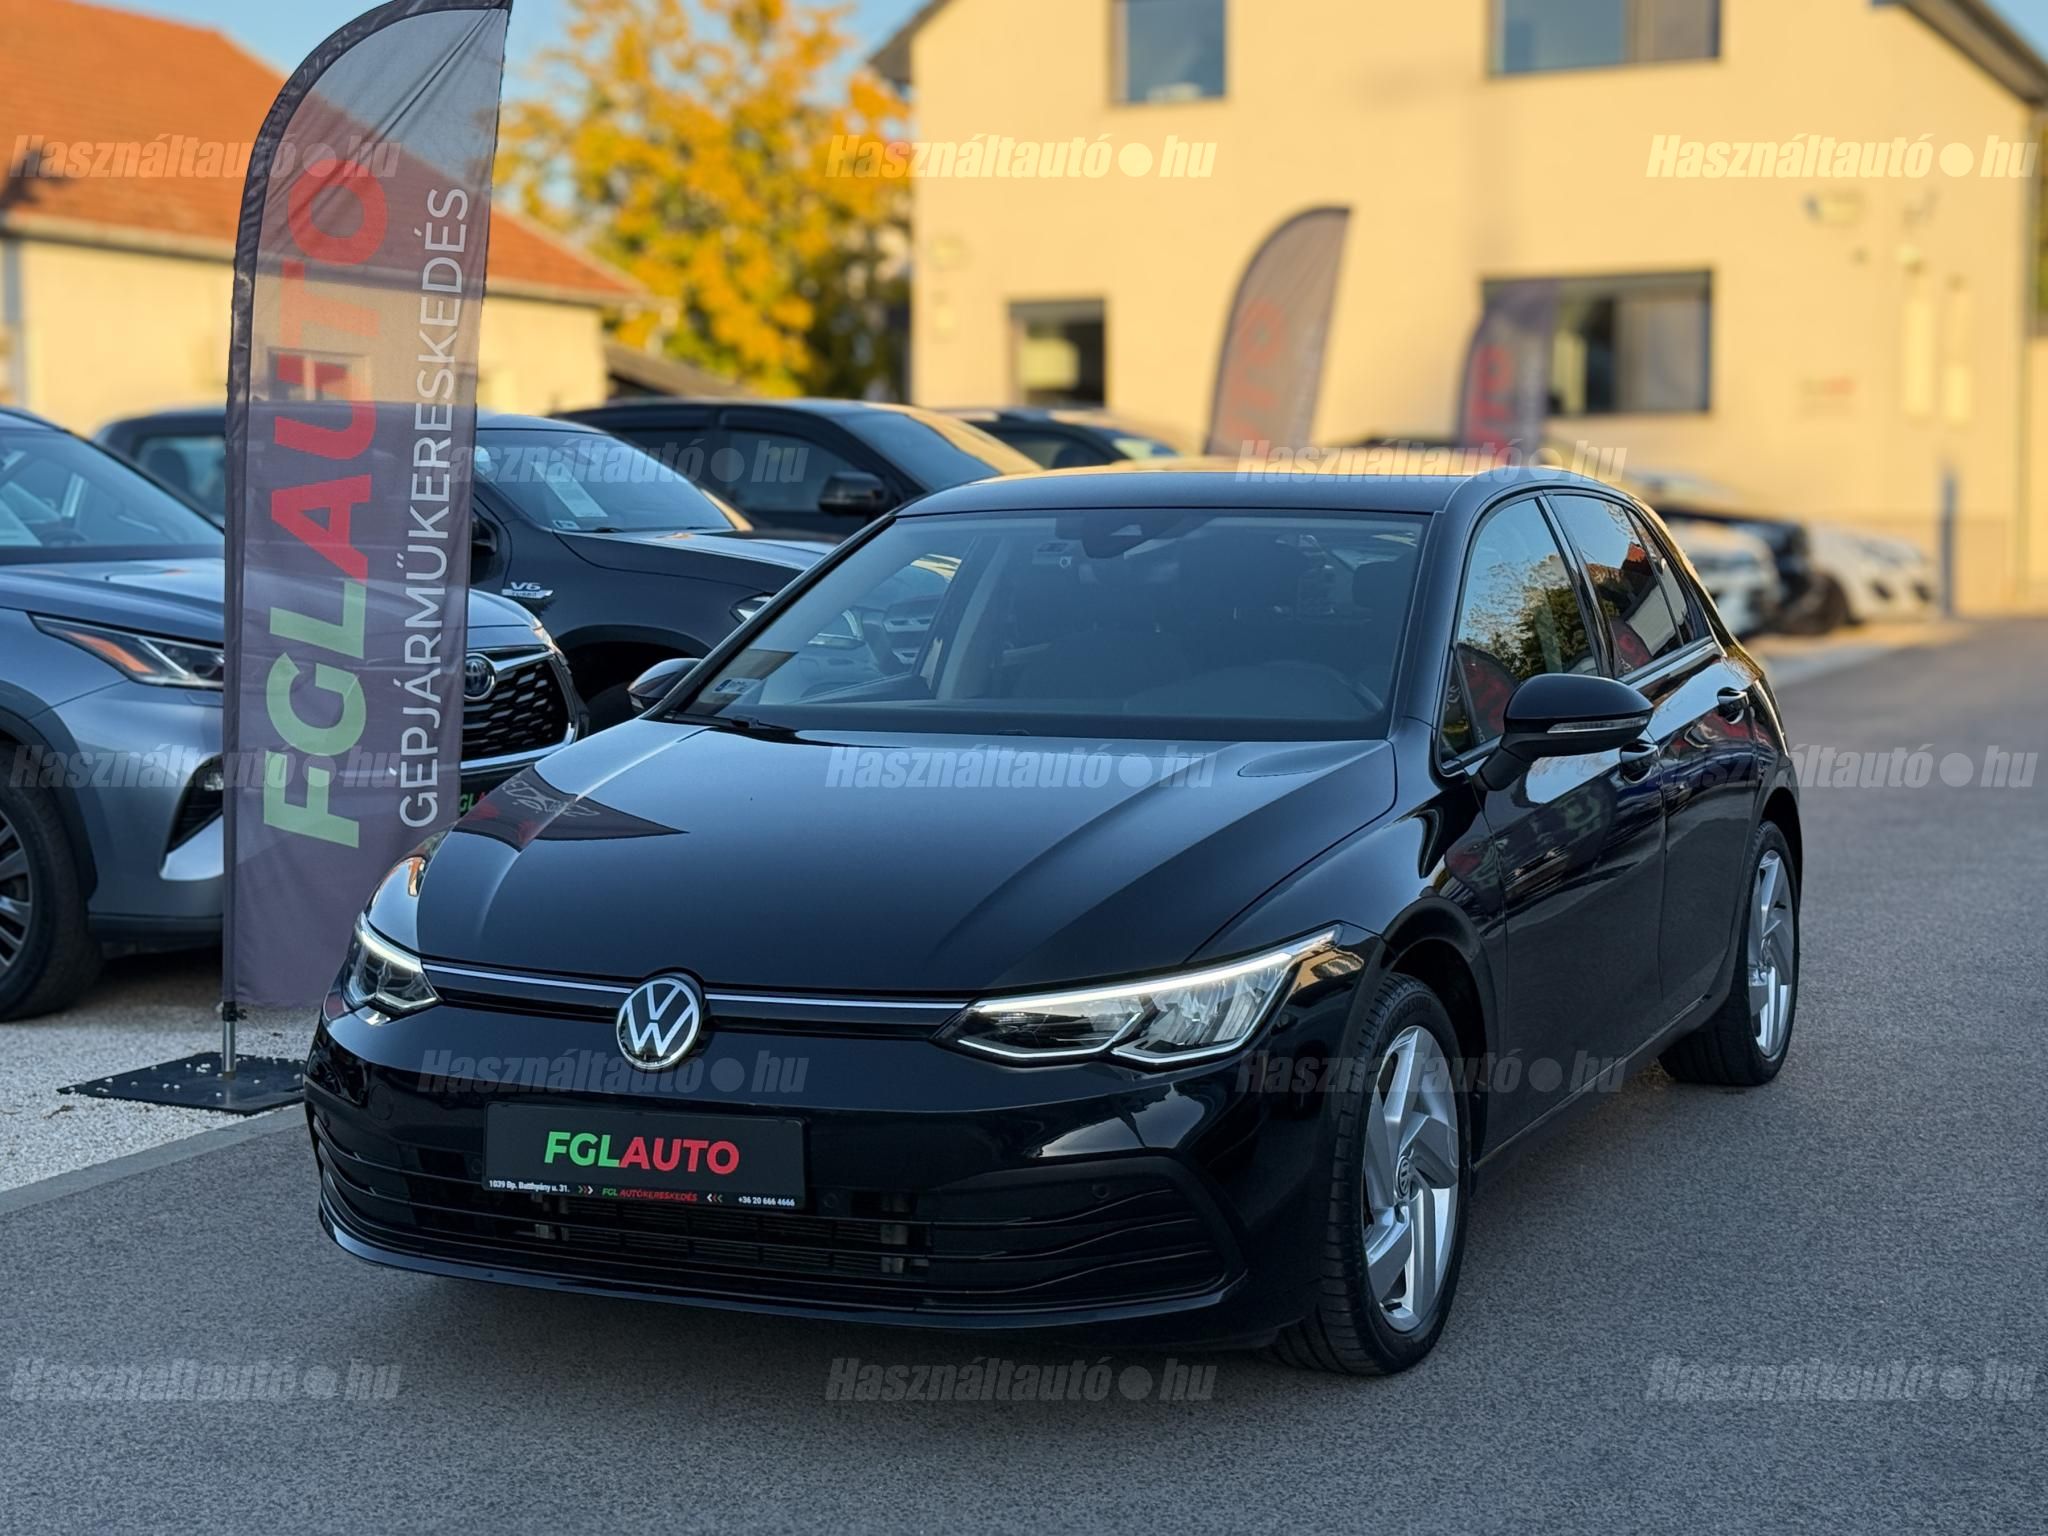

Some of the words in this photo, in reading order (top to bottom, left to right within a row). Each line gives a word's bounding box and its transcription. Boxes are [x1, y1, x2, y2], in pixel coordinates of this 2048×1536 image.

[263, 158, 389, 849] FGLAUTO
[510, 581, 541, 591] V6
[544, 1130, 741, 1175] FGLAUTO
[602, 1187, 618, 1197] FGL
[738, 1196, 752, 1204] +36
[752, 1196, 762, 1205] 20
